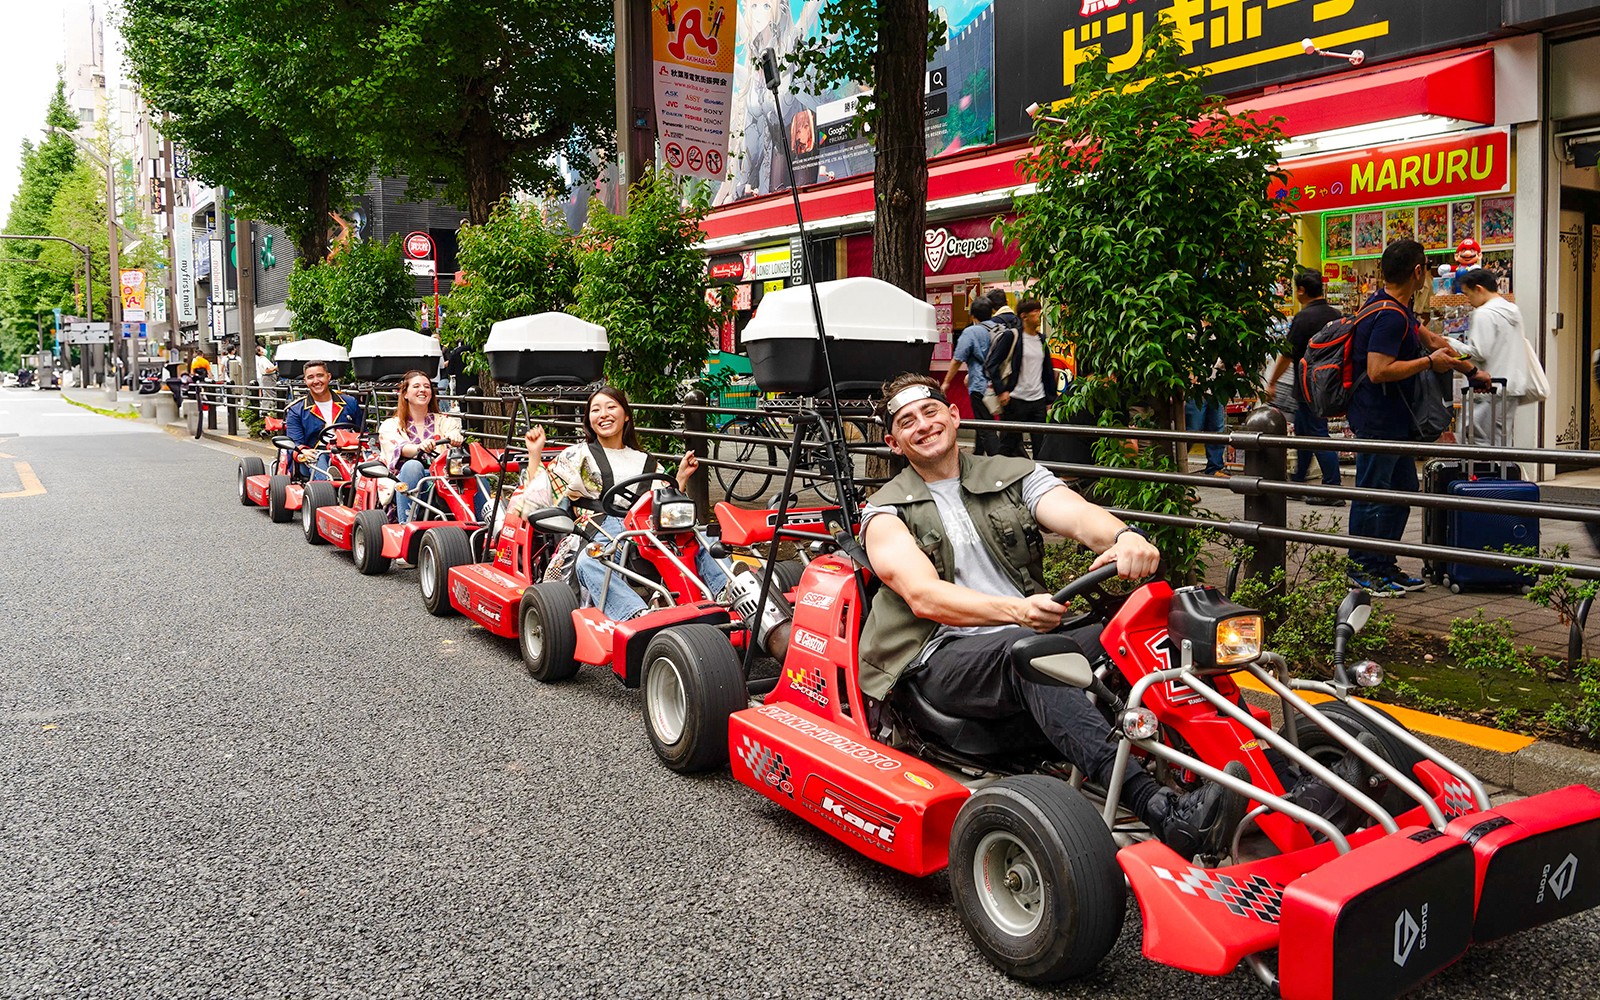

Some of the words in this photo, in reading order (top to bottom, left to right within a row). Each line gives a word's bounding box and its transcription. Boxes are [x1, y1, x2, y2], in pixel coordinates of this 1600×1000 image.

[686, 55, 717, 66] AKIHABARA
[685, 94, 701, 103] ASSY
[665, 100, 679, 108] JVC
[703, 108, 724, 116] SONY
[662, 120, 683, 128] Panasonic
[685, 123, 703, 132] HITACHI
[684, 113, 702, 122] TOSHIBA
[703, 117, 723, 126] DENON
[828, 125, 845, 136] Google
[1275, 181, 1344, 201] おもちゃの
[1350, 144, 1494, 195] MARURU
[946, 237, 989, 258] Crepes
[772, 261, 790, 275] LONGER
[477, 604, 501, 622] Kart
[801, 632, 826, 654] Castrol
[757, 706, 901, 770] STANDARDMOTO
[766, 772, 794, 793] 50
[801, 801, 895, 853] streetpower
[821, 797, 895, 843] Kart
